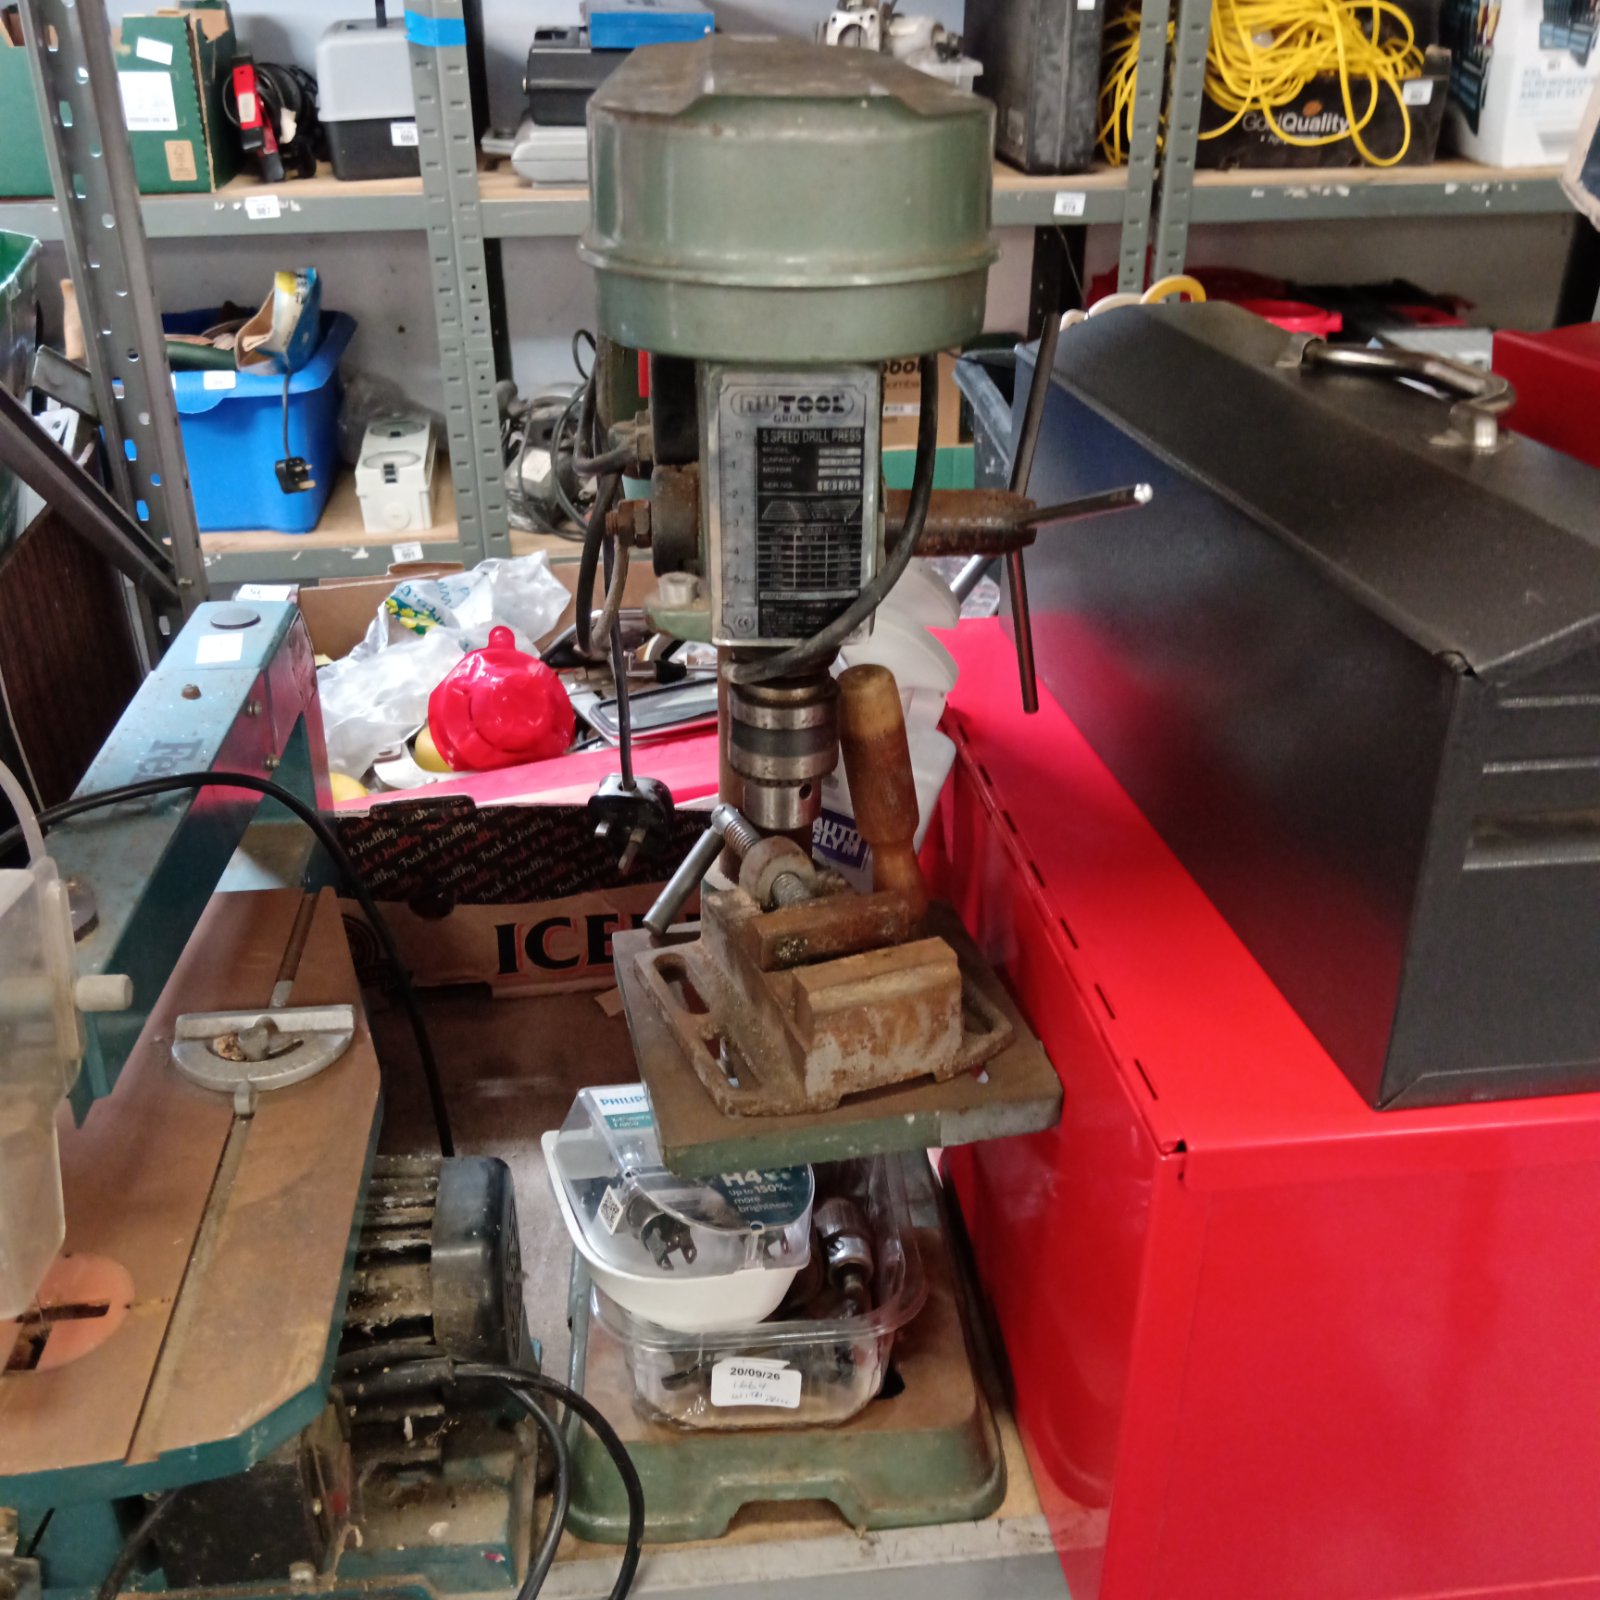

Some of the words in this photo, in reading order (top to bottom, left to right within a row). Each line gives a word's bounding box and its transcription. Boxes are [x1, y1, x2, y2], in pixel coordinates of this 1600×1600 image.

[770, 429, 800, 444] SPEED
[802, 428, 829, 443] DRILL
[831, 428, 861, 442] PRESS
[734, 1196, 761, 1205] more
[730, 1366, 781, 1381] 20/09/26
